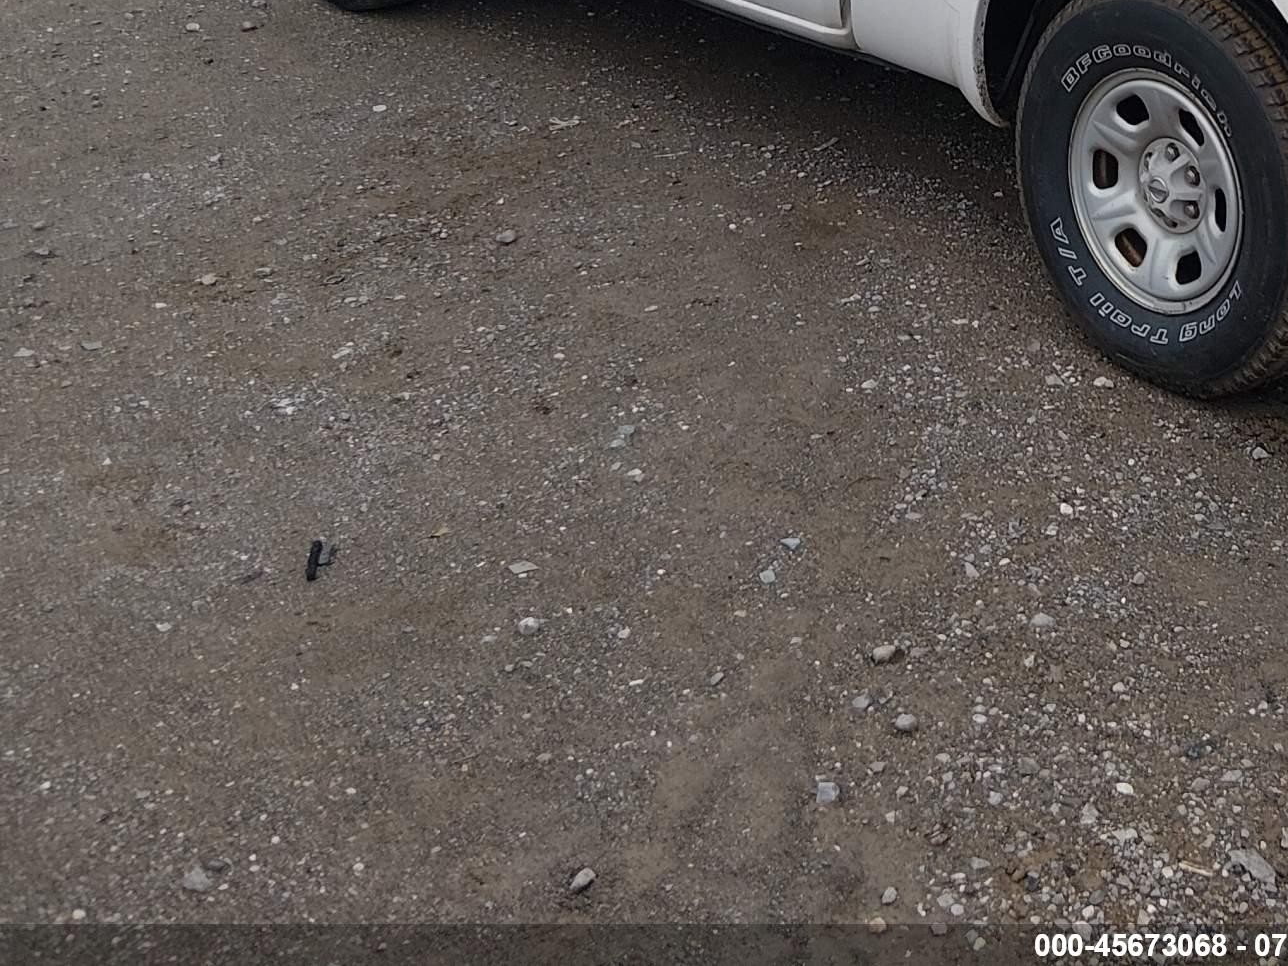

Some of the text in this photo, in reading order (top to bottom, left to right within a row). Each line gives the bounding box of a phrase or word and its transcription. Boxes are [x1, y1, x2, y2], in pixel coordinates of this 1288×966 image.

[1061, 44, 1233, 138] BFGoodrich
[1050, 217, 1243, 345] Long Trail T/A
